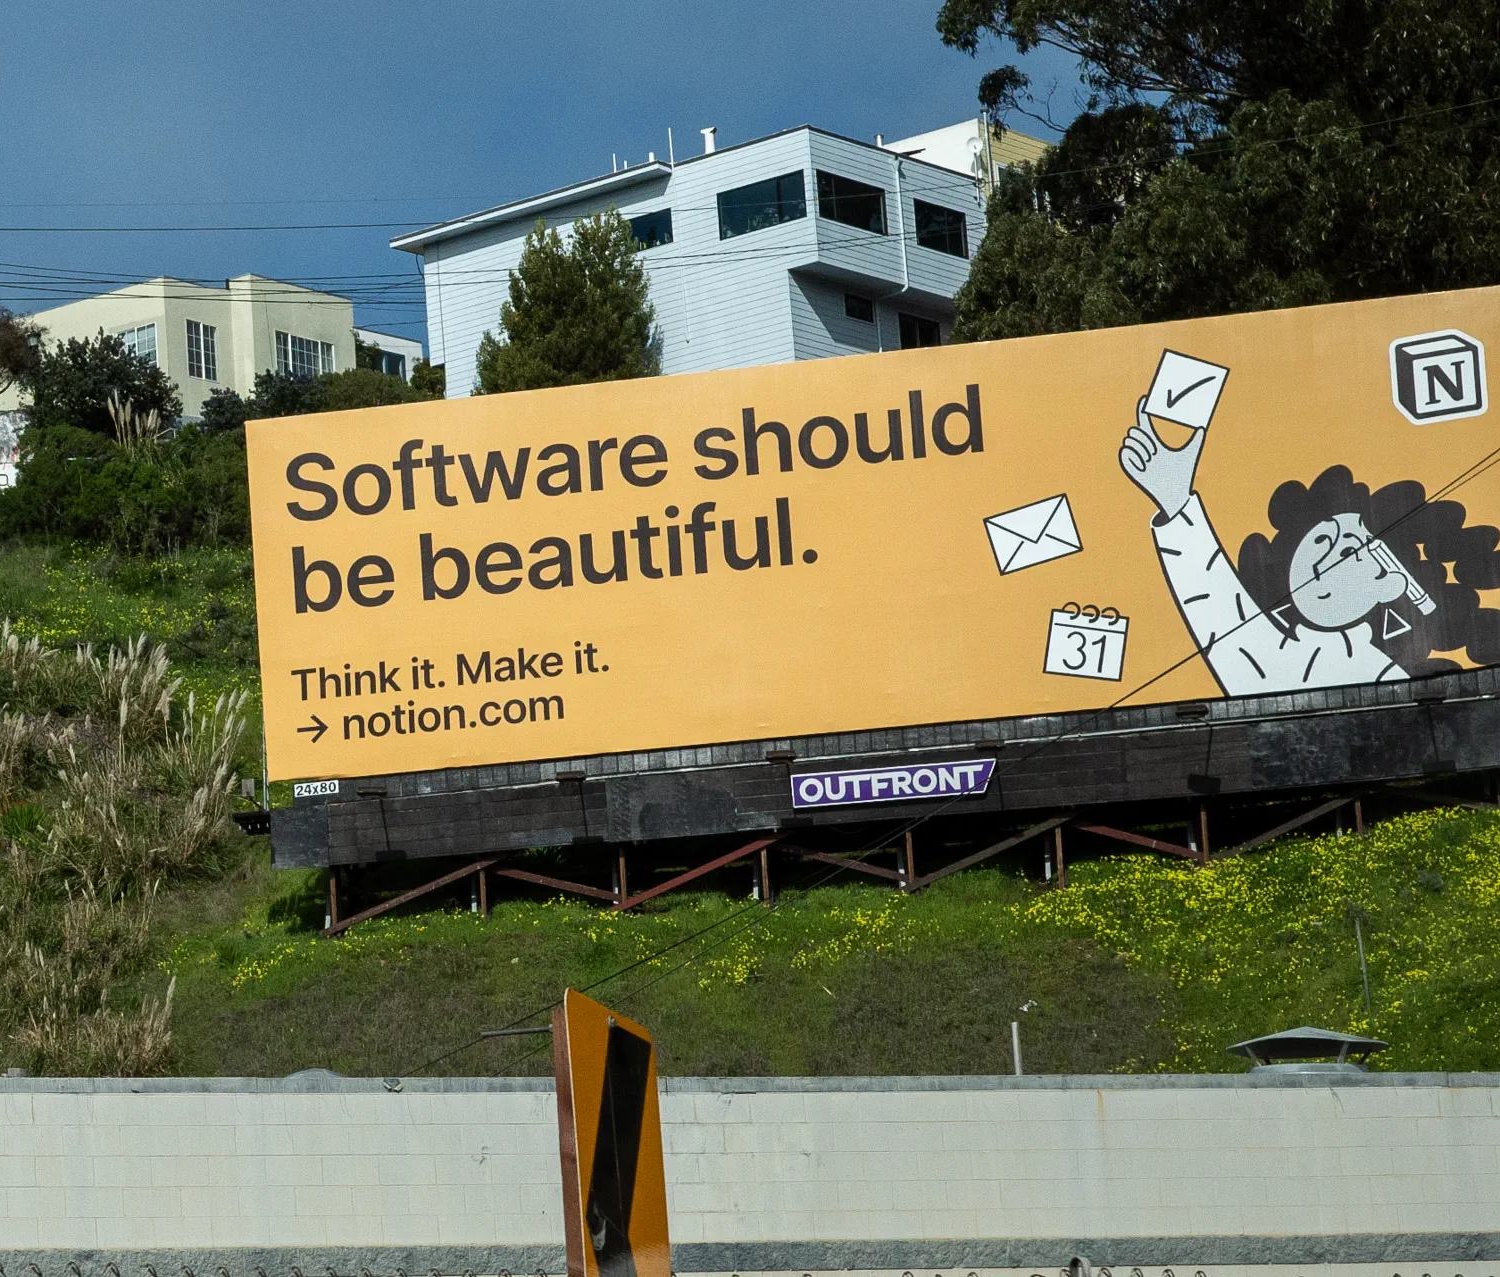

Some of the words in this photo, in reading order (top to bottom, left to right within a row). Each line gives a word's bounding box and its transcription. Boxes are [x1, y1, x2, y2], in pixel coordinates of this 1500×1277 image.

[1422, 360, 1465, 406] N
[286, 437, 668, 522] Software
[693, 383, 985, 480] should
[291, 545, 395, 614] be
[419, 496, 818, 601] beautiful.
[290, 666, 402, 701] Think
[411, 656, 446, 690] it.
[456, 647, 564, 686] Make
[574, 640, 610, 675] it.
[1062, 631, 1107, 673] 31
[343, 695, 565, 740] notion.com
[296, 781, 337, 796] 24x80
[799, 764, 984, 803] OUTFRONT
